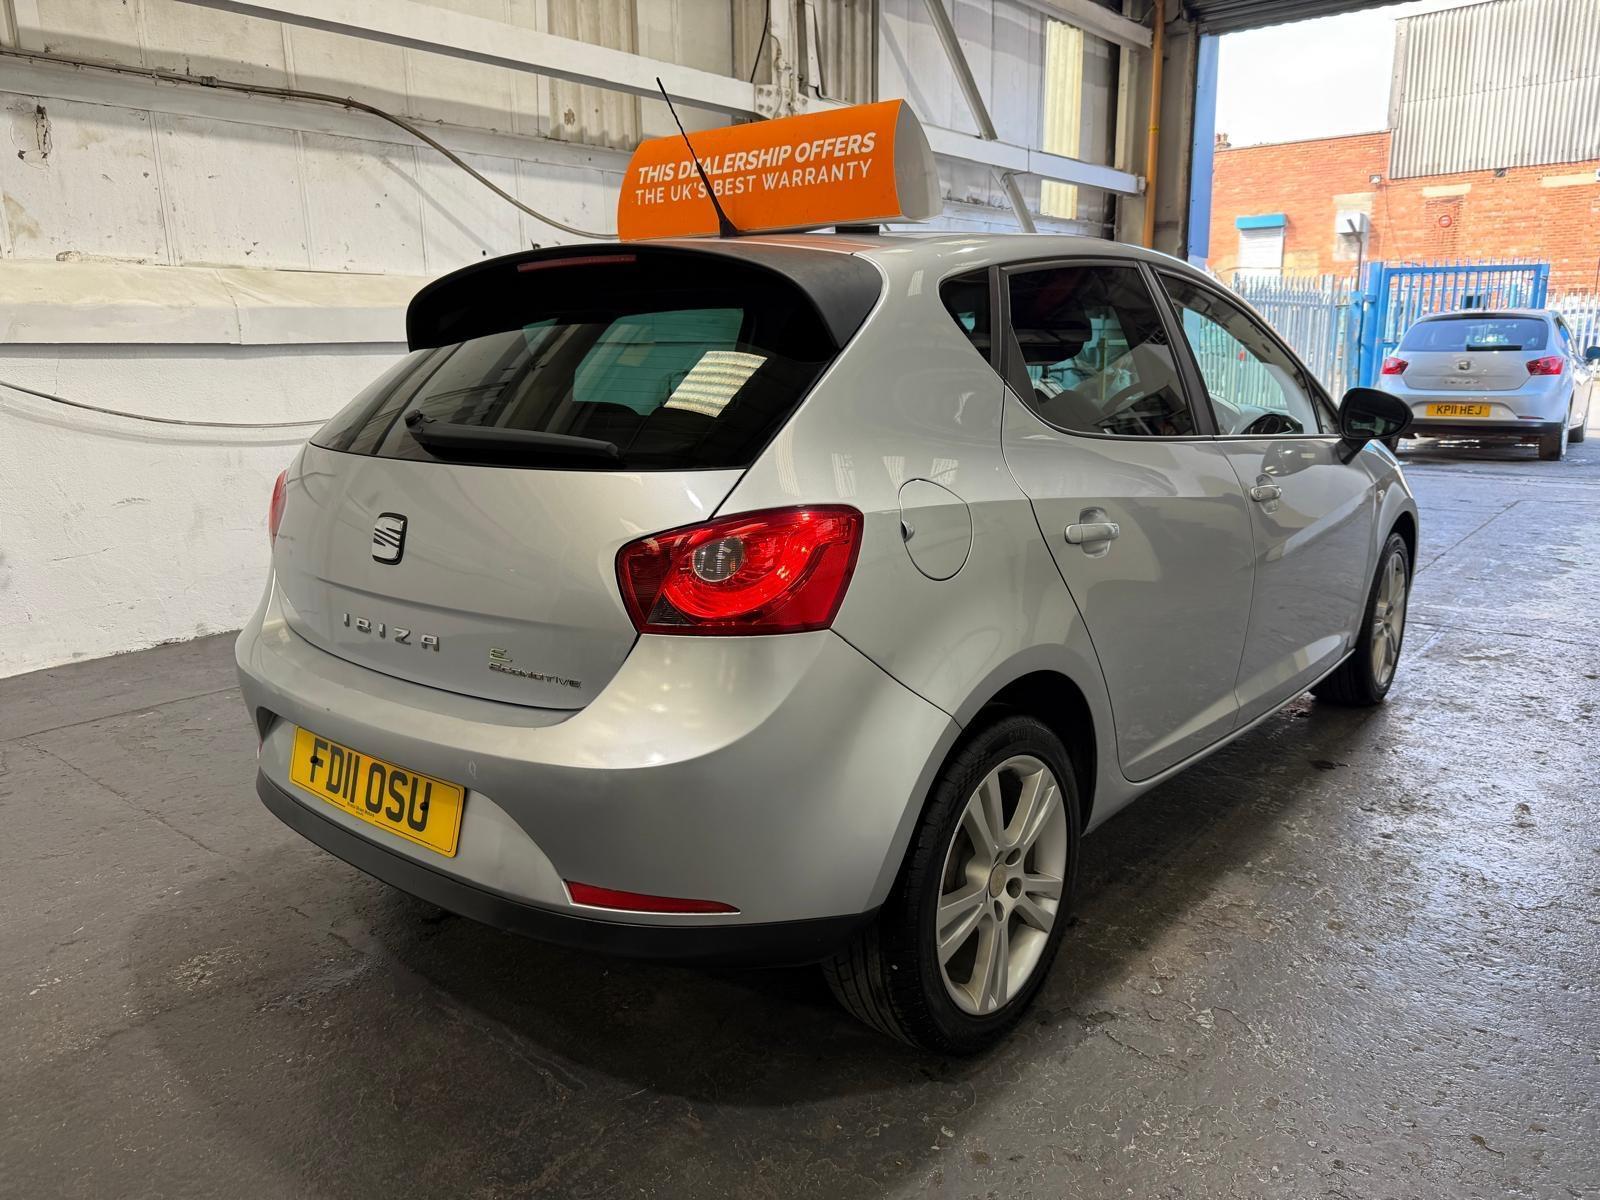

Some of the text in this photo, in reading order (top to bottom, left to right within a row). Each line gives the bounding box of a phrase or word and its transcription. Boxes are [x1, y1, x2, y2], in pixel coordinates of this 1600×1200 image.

[635, 158, 873, 206] THE UK'S BEST WARRANTY
[638, 131, 877, 185] THIS DEALERSHIP OFFERS
[1436, 404, 1482, 415] KP11 HEJ
[343, 612, 440, 652] IBIZA
[309, 737, 433, 833] FD11 OSU
